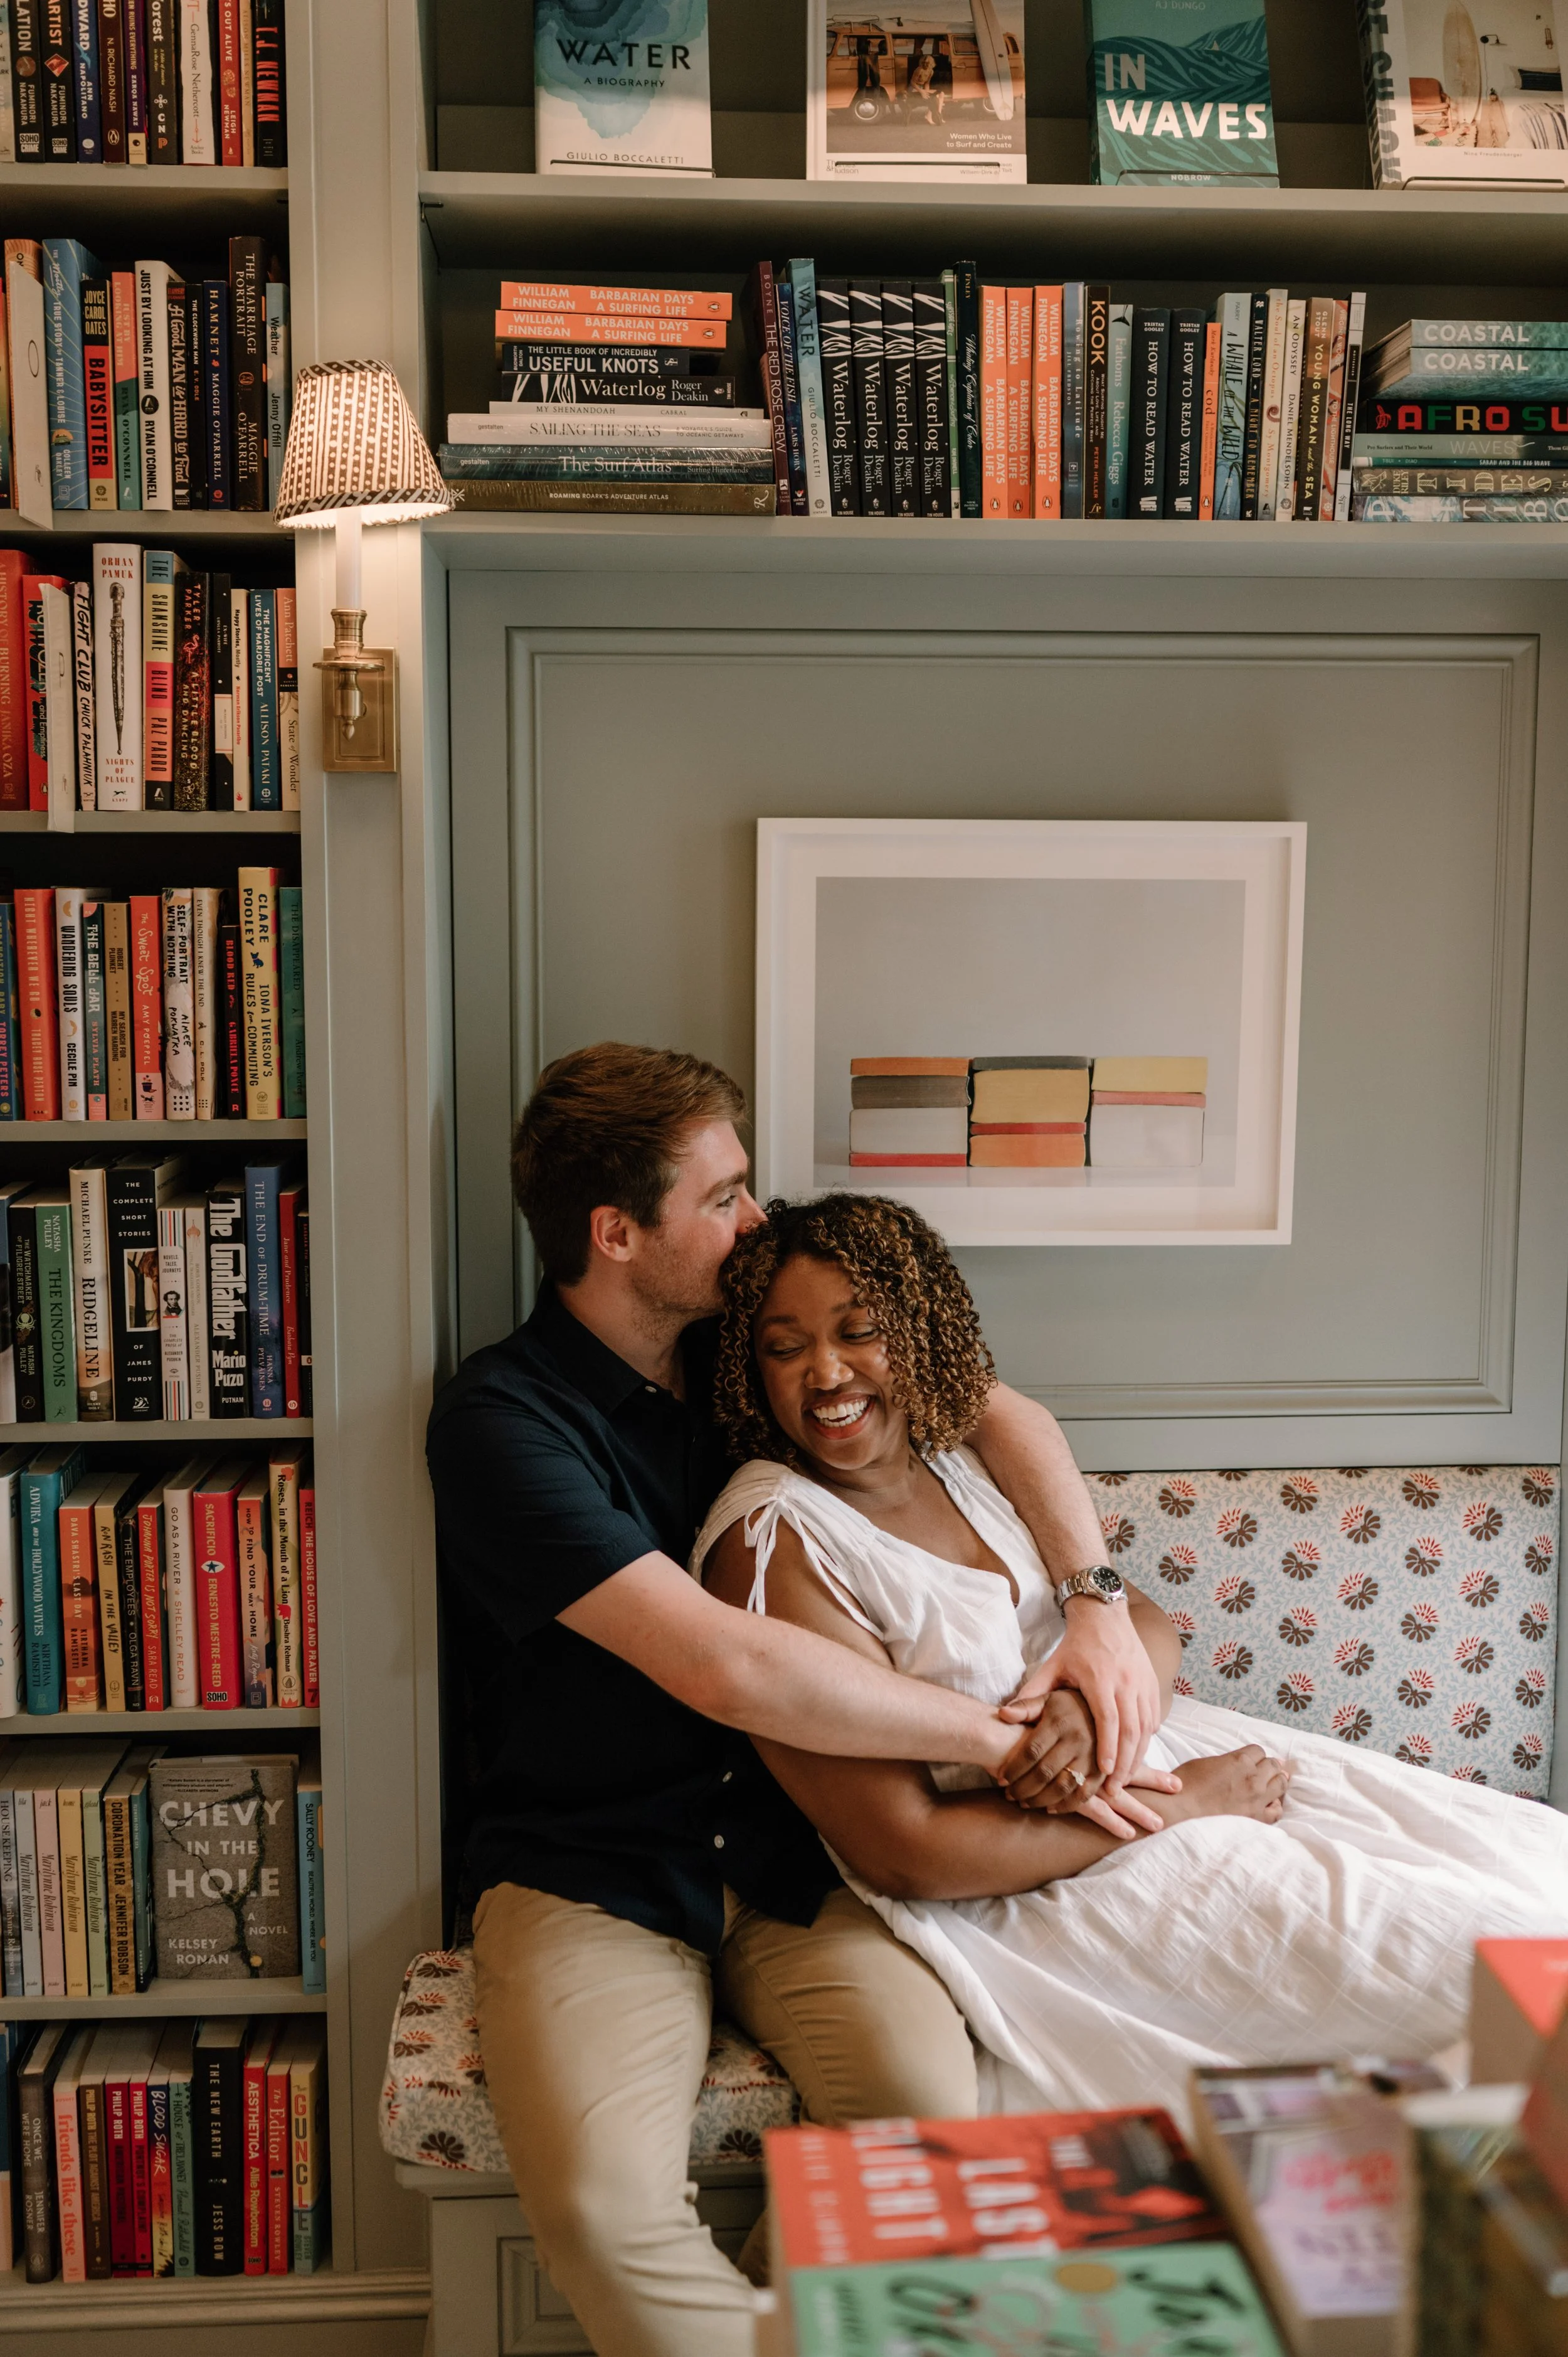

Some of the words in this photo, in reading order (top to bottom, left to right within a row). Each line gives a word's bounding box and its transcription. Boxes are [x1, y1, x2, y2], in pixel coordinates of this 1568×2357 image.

[556, 39, 691, 70] WATER
[597, 78, 665, 87] BIOGRAPHY
[1104, 54, 1145, 90] IN
[28, 85, 36, 123] FUMINORI
[1106, 99, 1266, 139] WAVES
[19, 133, 39, 144] SOHO
[21, 142, 40, 153] CRIME
[566, 152, 608, 161] GIULIO
[614, 154, 684, 164] BOCCALETTI
[140, 270, 151, 295] JUST
[518, 286, 569, 297] WILLIAM
[764, 275, 773, 313] BOYNE
[84, 290, 105, 304] JOYCE
[142, 297, 152, 310] BY
[512, 297, 575, 310] FINNEGAN
[590, 290, 659, 302] BARBARIAN
[664, 294, 694, 304] DAYS
[596, 302, 604, 311] A
[609, 303, 661, 314] SURFING
[666, 306, 686, 316] LIFE
[85, 306, 105, 319] CAROL
[209, 289, 220, 355] HAMNET
[797, 287, 815, 357] WATER
[1292, 315, 1299, 329] AN
[85, 321, 107, 336] OATES
[142, 313, 153, 354] LOOKING
[270, 317, 280, 355] Weather
[765, 322, 776, 346] THE
[1091, 301, 1104, 365] KOOK
[1424, 324, 1529, 342] COASTAL
[143, 356, 153, 368] AT
[611, 348, 657, 356] INCREDIBLY
[768, 349, 778, 375] RED
[1147, 341, 1158, 376] HOW
[1290, 333, 1300, 376] ODYSSEY
[1424, 353, 1529, 371] COASTAL
[528, 356, 596, 372] USEFUL
[602, 358, 659, 374] KNOTS
[1312, 344, 1325, 390] YOUNG
[143, 370, 154, 390] HIM
[580, 380, 666, 400] Waterlog
[672, 380, 702, 391] Roger
[1147, 378, 1157, 396] TO
[211, 373, 220, 417] MAGGIE
[271, 393, 280, 418] Jenny
[672, 390, 708, 401] Deakin
[770, 379, 782, 413] ROSE
[833, 361, 852, 449] Waterlog
[88, 357, 109, 466] BABYSITTER
[1145, 401, 1157, 437] READ
[1287, 394, 1296, 425] DANIEL
[1308, 396, 1320, 444] WOMAN
[1397, 405, 1510, 431] AFRO
[144, 420, 155, 445] RYAN
[271, 421, 281, 448] Offill
[530, 423, 587, 435] SAILING
[591, 423, 619, 436] THE
[624, 425, 660, 437] SEAS
[773, 416, 785, 453] CREW
[213, 421, 221, 480] O'FARRELL
[1284, 429, 1295, 489] MENDELSOHN
[145, 448, 157, 501] O'CONNELL
[559, 456, 590, 471] The
[595, 457, 627, 472] Surf
[632, 457, 671, 472] Atlas
[833, 455, 842, 492] Deakin
[844, 454, 853, 485] Roger
[1144, 441, 1155, 486] WATER
[1303, 476, 1314, 499] SEA
[102, 557, 134, 567] ORHAN
[102, 568, 134, 578] PAMUK
[75, 592, 90, 646] FIGHT
[76, 649, 91, 693] CLUB
[105, 758, 134, 767] NIGHTS
[105, 775, 135, 784] PLAGUE
[243, 888, 254, 946] POOLEY
[258, 893, 270, 943] CLARE
[87, 923, 99, 949] THE
[60, 925, 77, 977] WANDERING
[87, 954, 99, 984] BELL
[63, 984, 78, 1013] SOULS
[87, 988, 100, 1013] JAR
[66, 1043, 78, 1070] CECILE
[68, 1072, 78, 1088] PIN
[80, 1181, 90, 1227] MICHAEL
[83, 1230, 92, 1264] PUNKE
[82, 1277, 100, 1378] RIDGELINE
[212, 1349, 246, 1368] Mario
[215, 1369, 244, 1386] Puzo
[171, 1507, 178, 1521] GO
[171, 1524, 178, 1538] AS
[205, 1503, 216, 1556] SACRIFICIO
[172, 1553, 181, 1585] RIVER
[206, 1691, 227, 1702] SOHO
[158, 1799, 285, 1827] CHEVY
[111, 1802, 124, 1857] CORONATION
[188, 1841, 209, 1855] IN
[220, 1840, 257, 1854] THE
[114, 1861, 125, 1886] YEAR
[167, 1867, 281, 1898] HOLE
[247, 1912, 255, 1921] A
[249, 1925, 289, 1935] NOVEL
[168, 1938, 218, 1950] KELSEY
[176, 1954, 230, 1965] RONAN
[209, 2063, 220, 2085] THE
[113, 2090, 122, 2117] PHILIP
[210, 2091, 221, 2115] NEW
[114, 2119, 123, 2139] ROTH
[248, 2081, 260, 2160] AESTHETICA
[211, 2121, 221, 2158] EARTH
